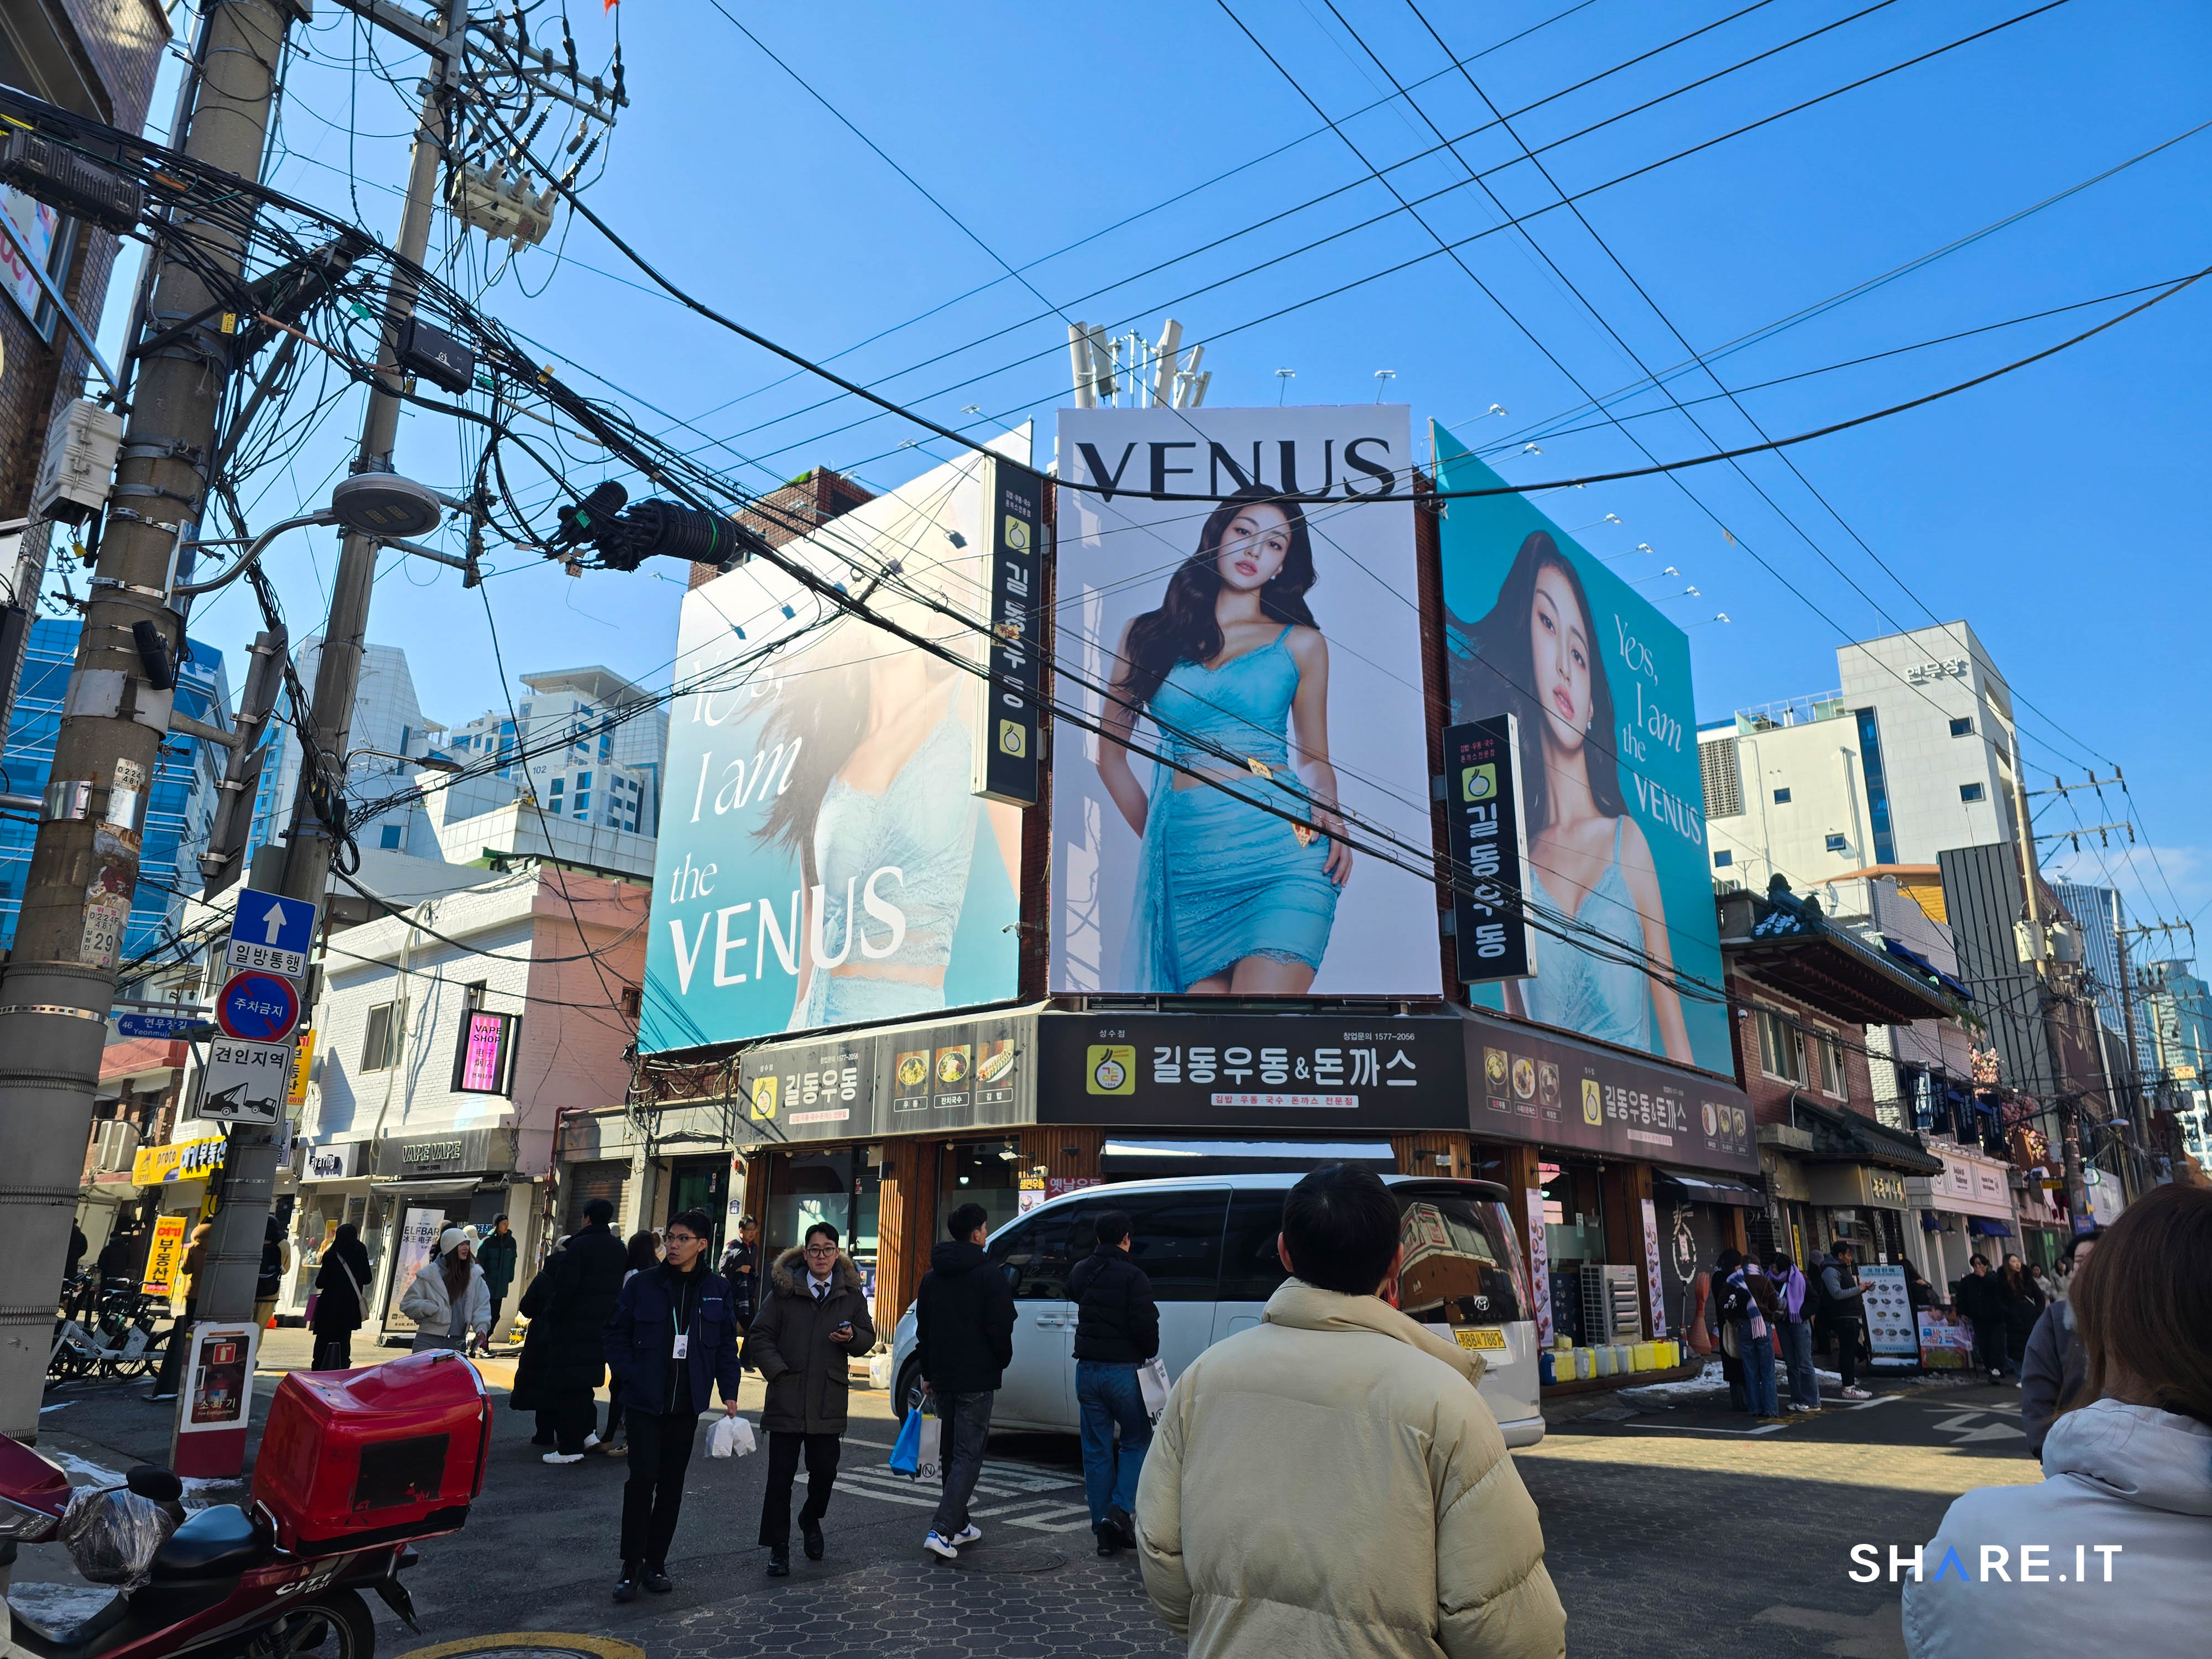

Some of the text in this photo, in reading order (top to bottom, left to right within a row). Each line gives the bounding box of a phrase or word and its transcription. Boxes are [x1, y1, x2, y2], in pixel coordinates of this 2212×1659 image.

[1075, 437, 1396, 503] VENUS
[1614, 613, 1658, 686] Yes,
[1907, 656, 1961, 682] 연무장
[1648, 706, 1683, 753] am
[1623, 725, 1646, 763] the
[123, 776, 139, 786] 481
[714, 737, 802, 815] am
[1633, 772, 1702, 847] VENUS
[670, 853, 717, 904] the
[1467, 803, 1506, 959] 길동우동
[95, 921, 112, 931] 481
[669, 866, 906, 995] VENUS
[93, 932, 113, 952] 29
[236, 945, 300, 973] 일방통행
[234, 998, 283, 1018] 주차금지
[144, 1018, 187, 1030] 연무장길
[476, 1024, 502, 1035] VAPE
[1099, 1029, 1126, 1038] 성수점
[473, 1034, 501, 1044] SHOP
[1343, 1032, 1415, 1041] 창업문의 1577-2056
[215, 1046, 285, 1069] 견인지역
[476, 1048, 493, 1058] 电子
[1153, 1045, 1417, 1087] 길동우동&돈까스
[784, 1067, 857, 1107] 길동우동
[987, 1092, 1003, 1100] 김밥
[903, 1100, 919, 1108] 우동
[941, 1095, 963, 1105] 잔치국수
[1215, 1095, 1233, 1104] 김밥
[1266, 1096, 1284, 1104] 국수
[1291, 1097, 1319, 1105] 돈까스
[1325, 1097, 1354, 1105] 전문점
[1605, 1085, 1688, 1131] 길동우동&돈까스
[156, 1150, 176, 1168] proto
[403, 1141, 462, 1162] VAPE VAPE
[158, 1227, 182, 1237] 여기
[404, 1226, 440, 1236] ELFBAR
[152, 1239, 174, 1281] 부동산
[199, 1397, 236, 1410] 소화기
[275, 1572, 332, 1595] CITI
